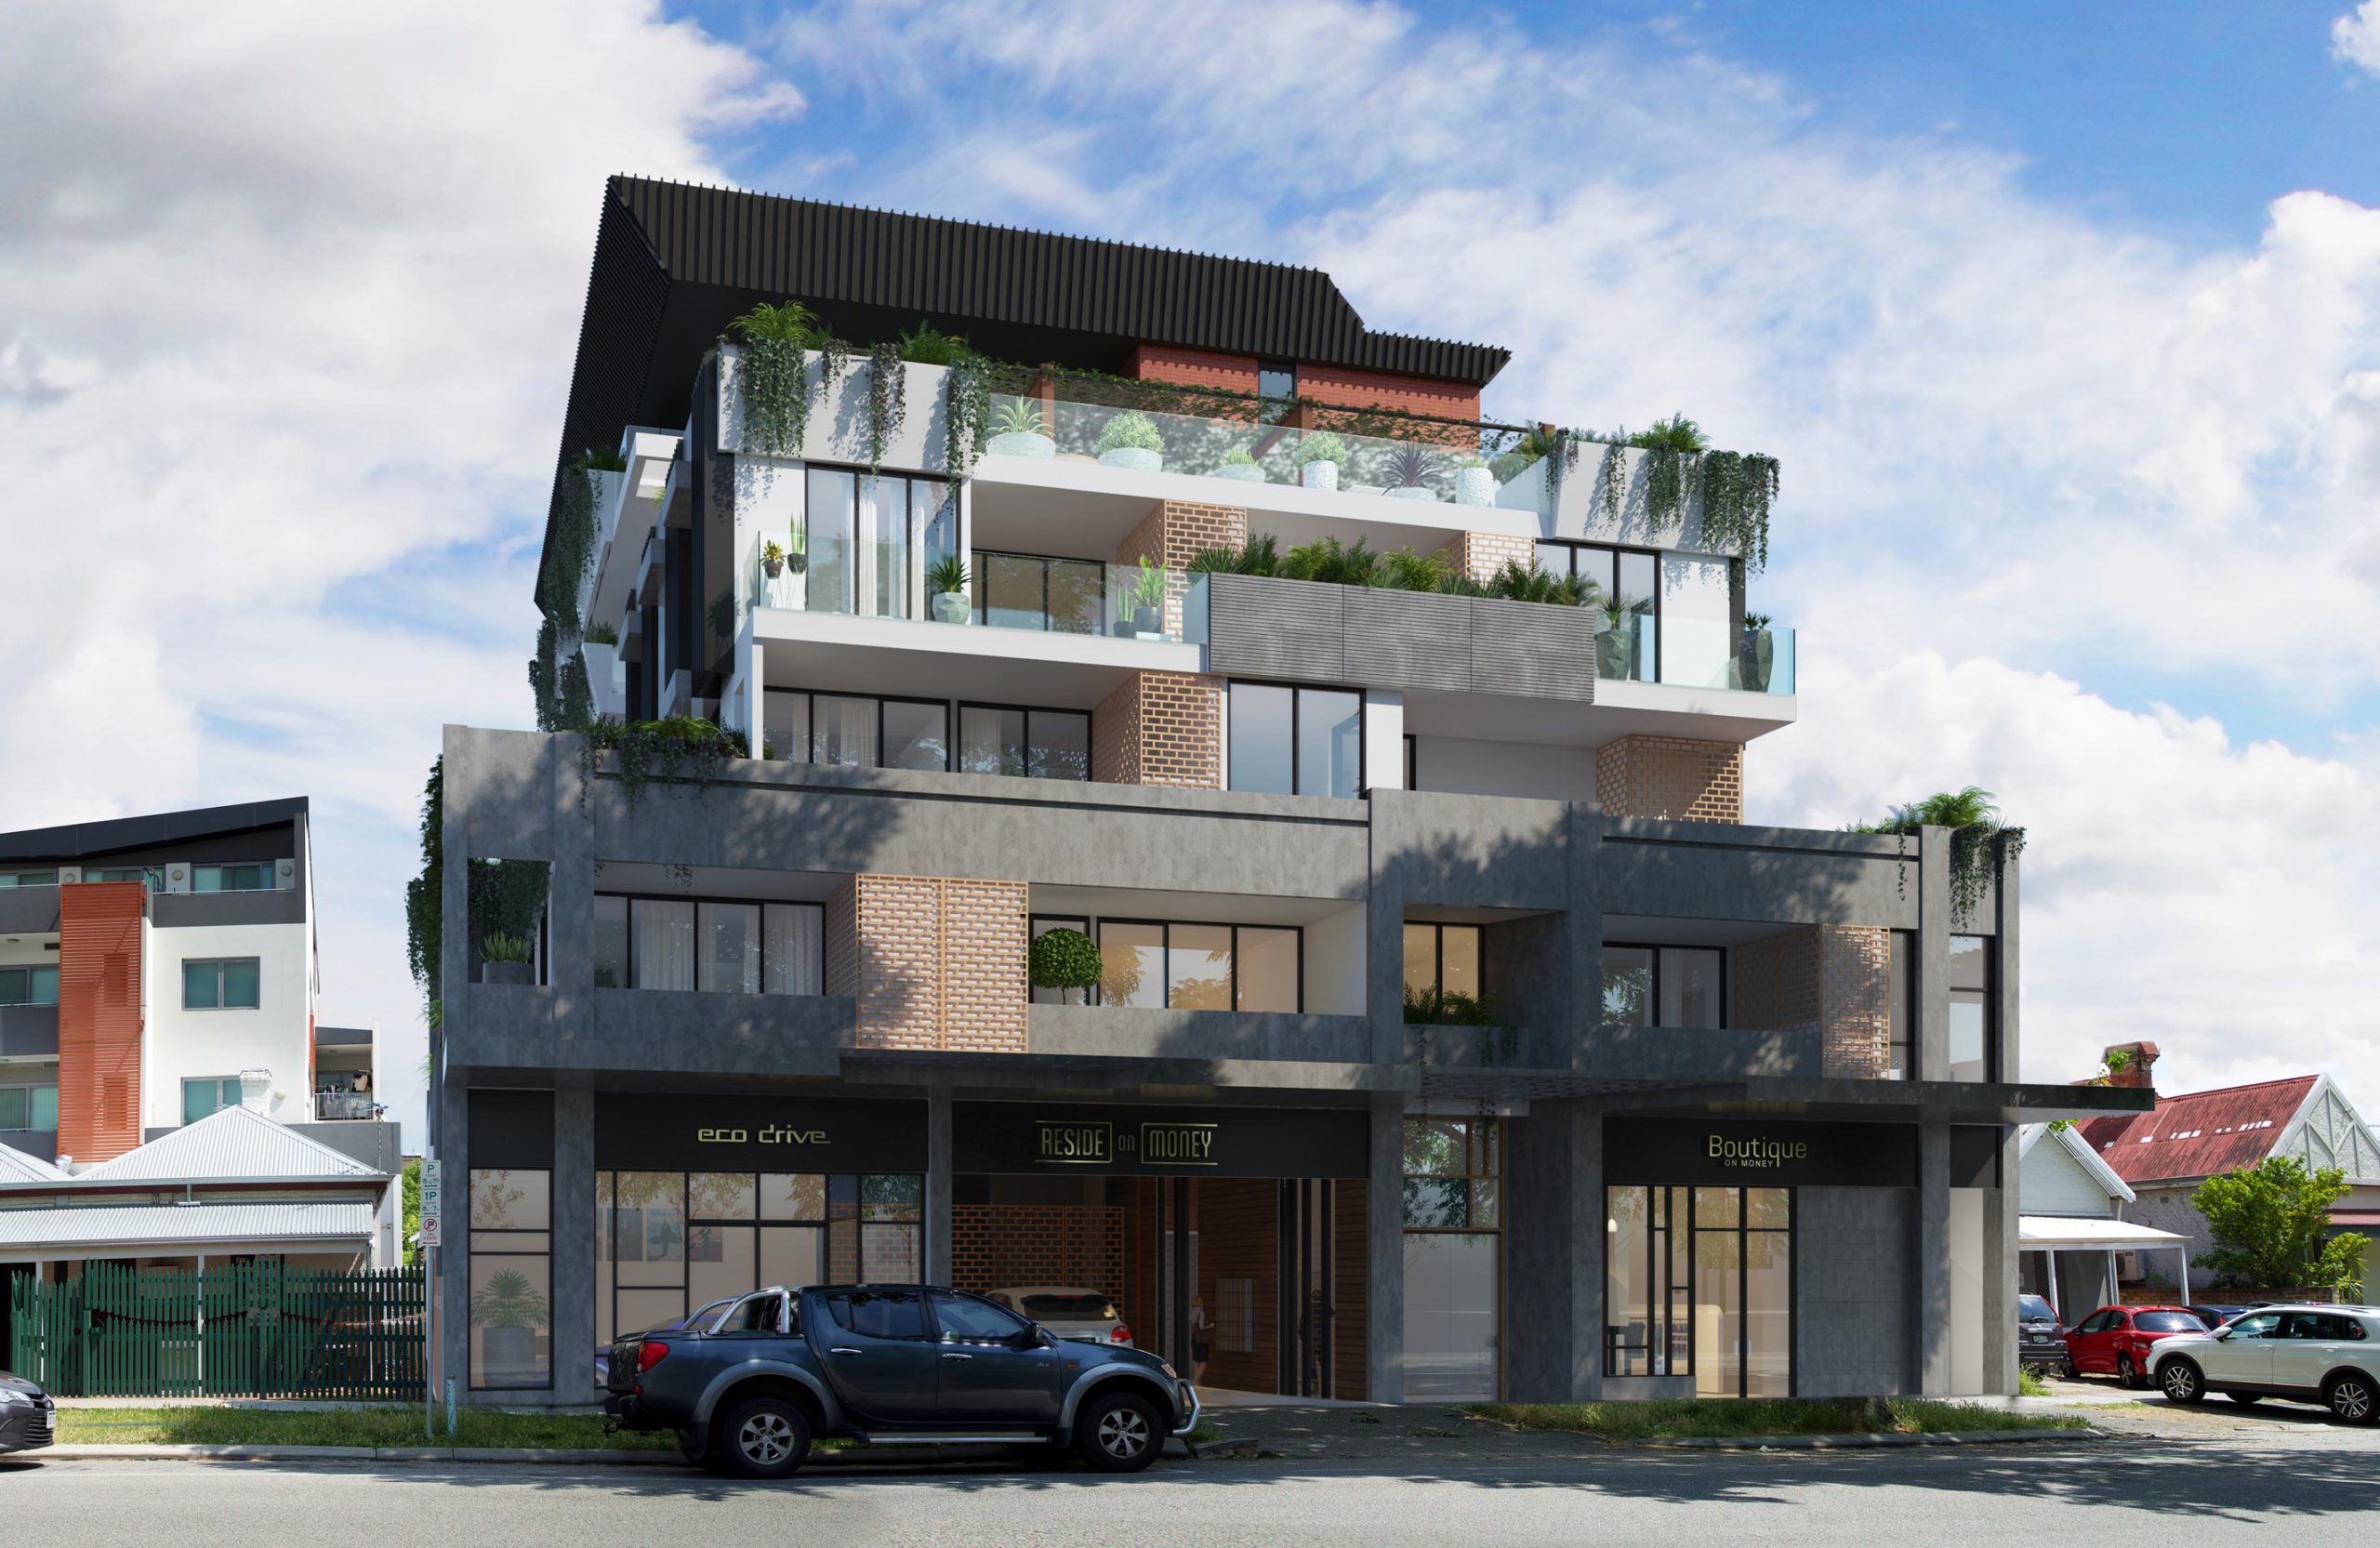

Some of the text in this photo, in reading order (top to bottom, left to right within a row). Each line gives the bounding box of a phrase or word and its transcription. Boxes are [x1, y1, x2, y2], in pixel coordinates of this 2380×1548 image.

[697, 1123, 831, 1144] eco drive
[1040, 1127, 1104, 1157] RESIDE
[1148, 1129, 1212, 1158] MONEY
[1709, 1135, 1806, 1168] Boutique
[427, 1164, 435, 1173] P
[1725, 1158, 1774, 1168] ON MONEY
[425, 1191, 437, 1200] 1P
